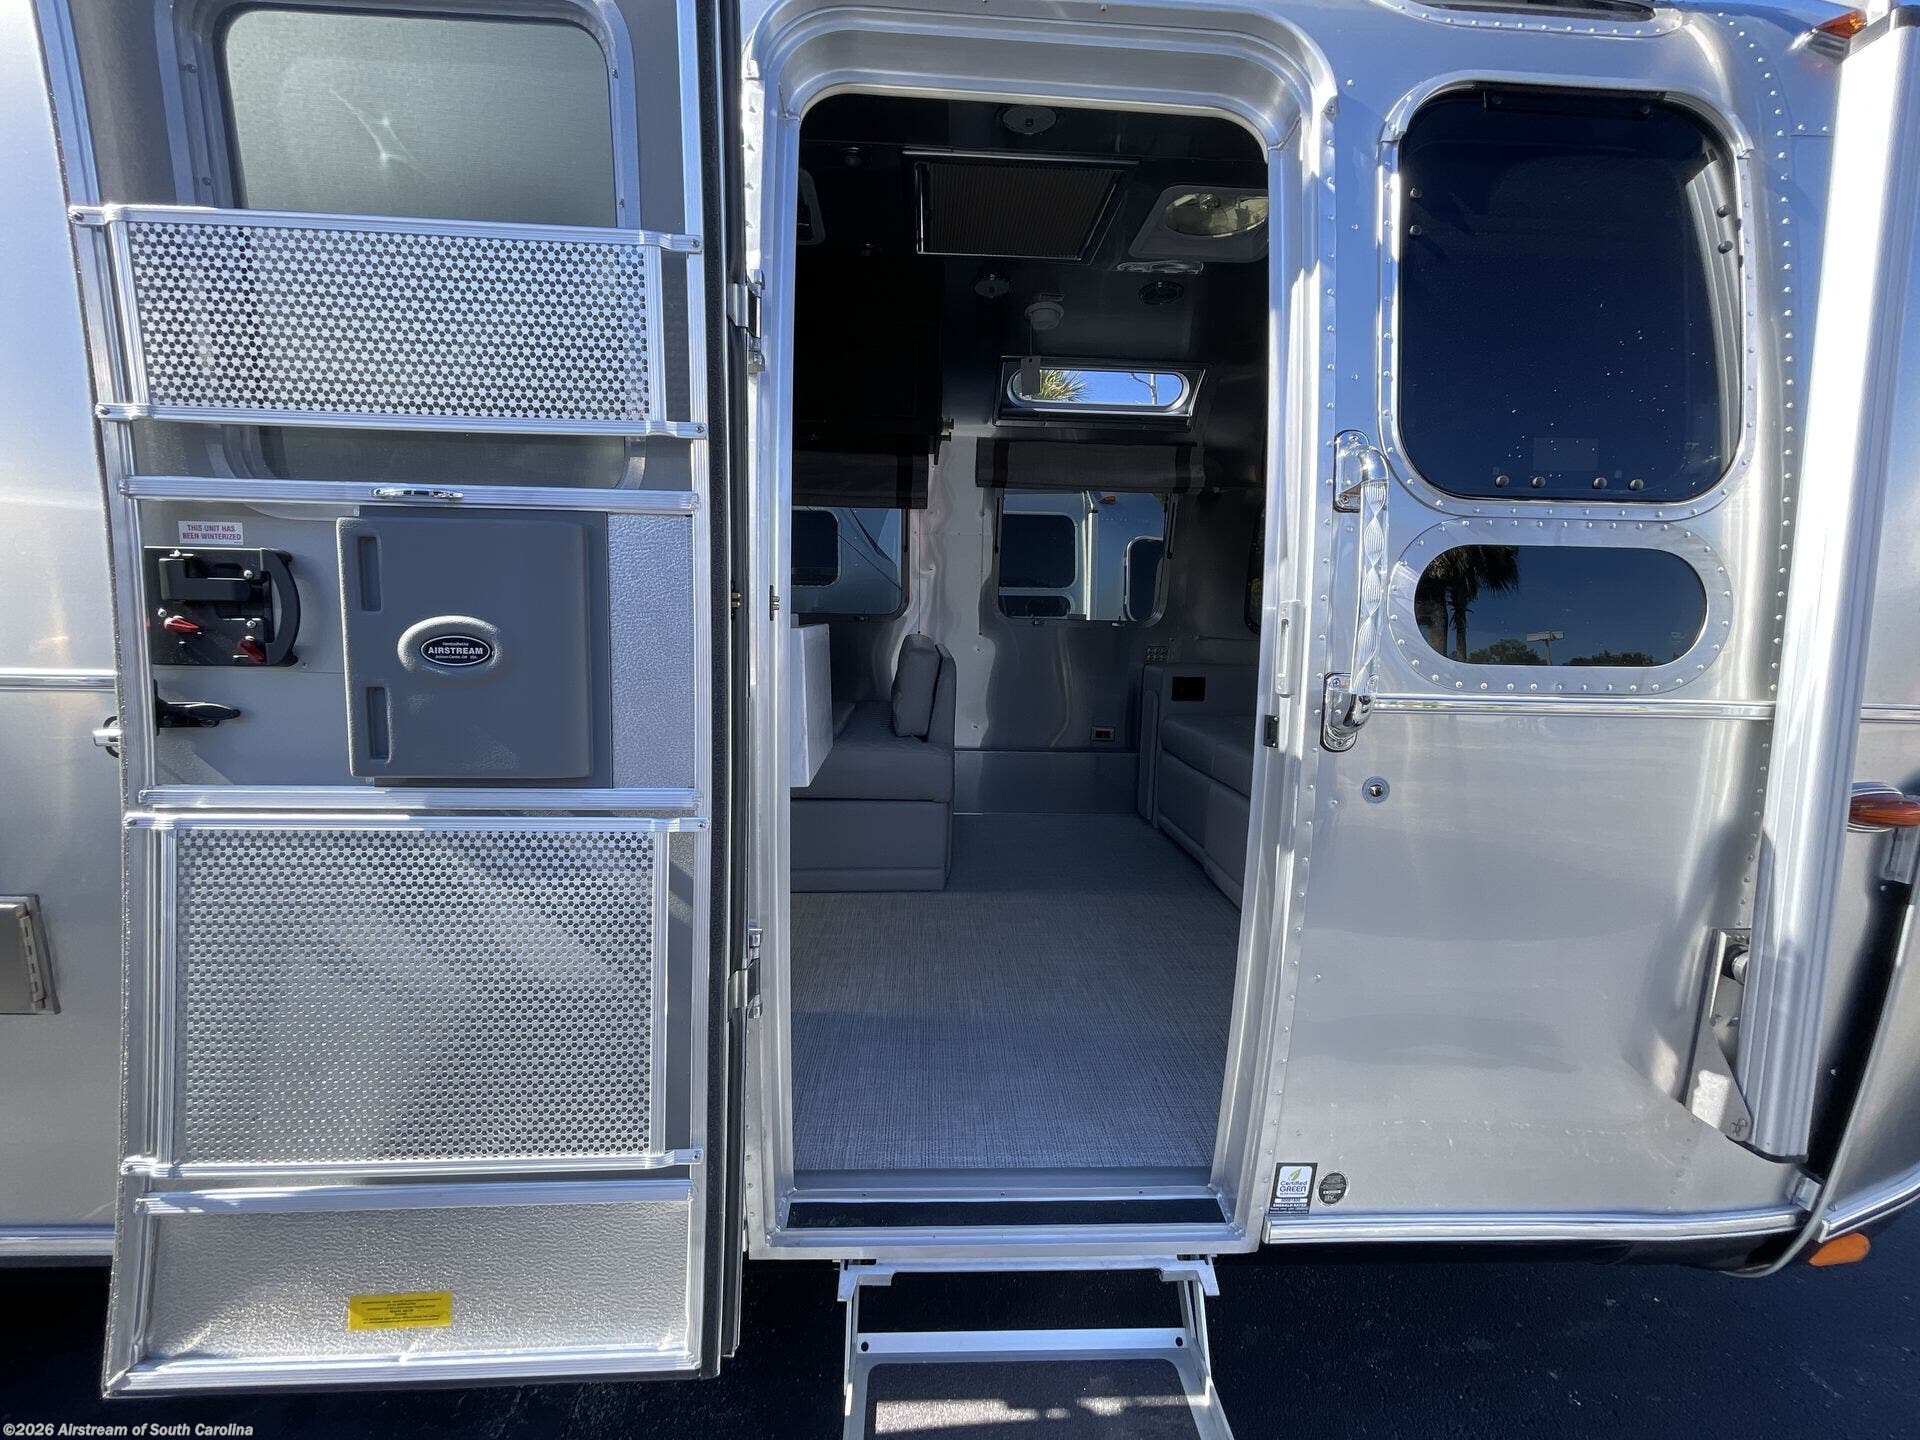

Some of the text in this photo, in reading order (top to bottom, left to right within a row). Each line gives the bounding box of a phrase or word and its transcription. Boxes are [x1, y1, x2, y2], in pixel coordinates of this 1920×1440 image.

[187, 524, 203, 532] THIS
[204, 524, 220, 532] UNIT
[428, 646, 483, 655] AIRSTREAM
[1279, 1185, 1307, 1193] GREEN
